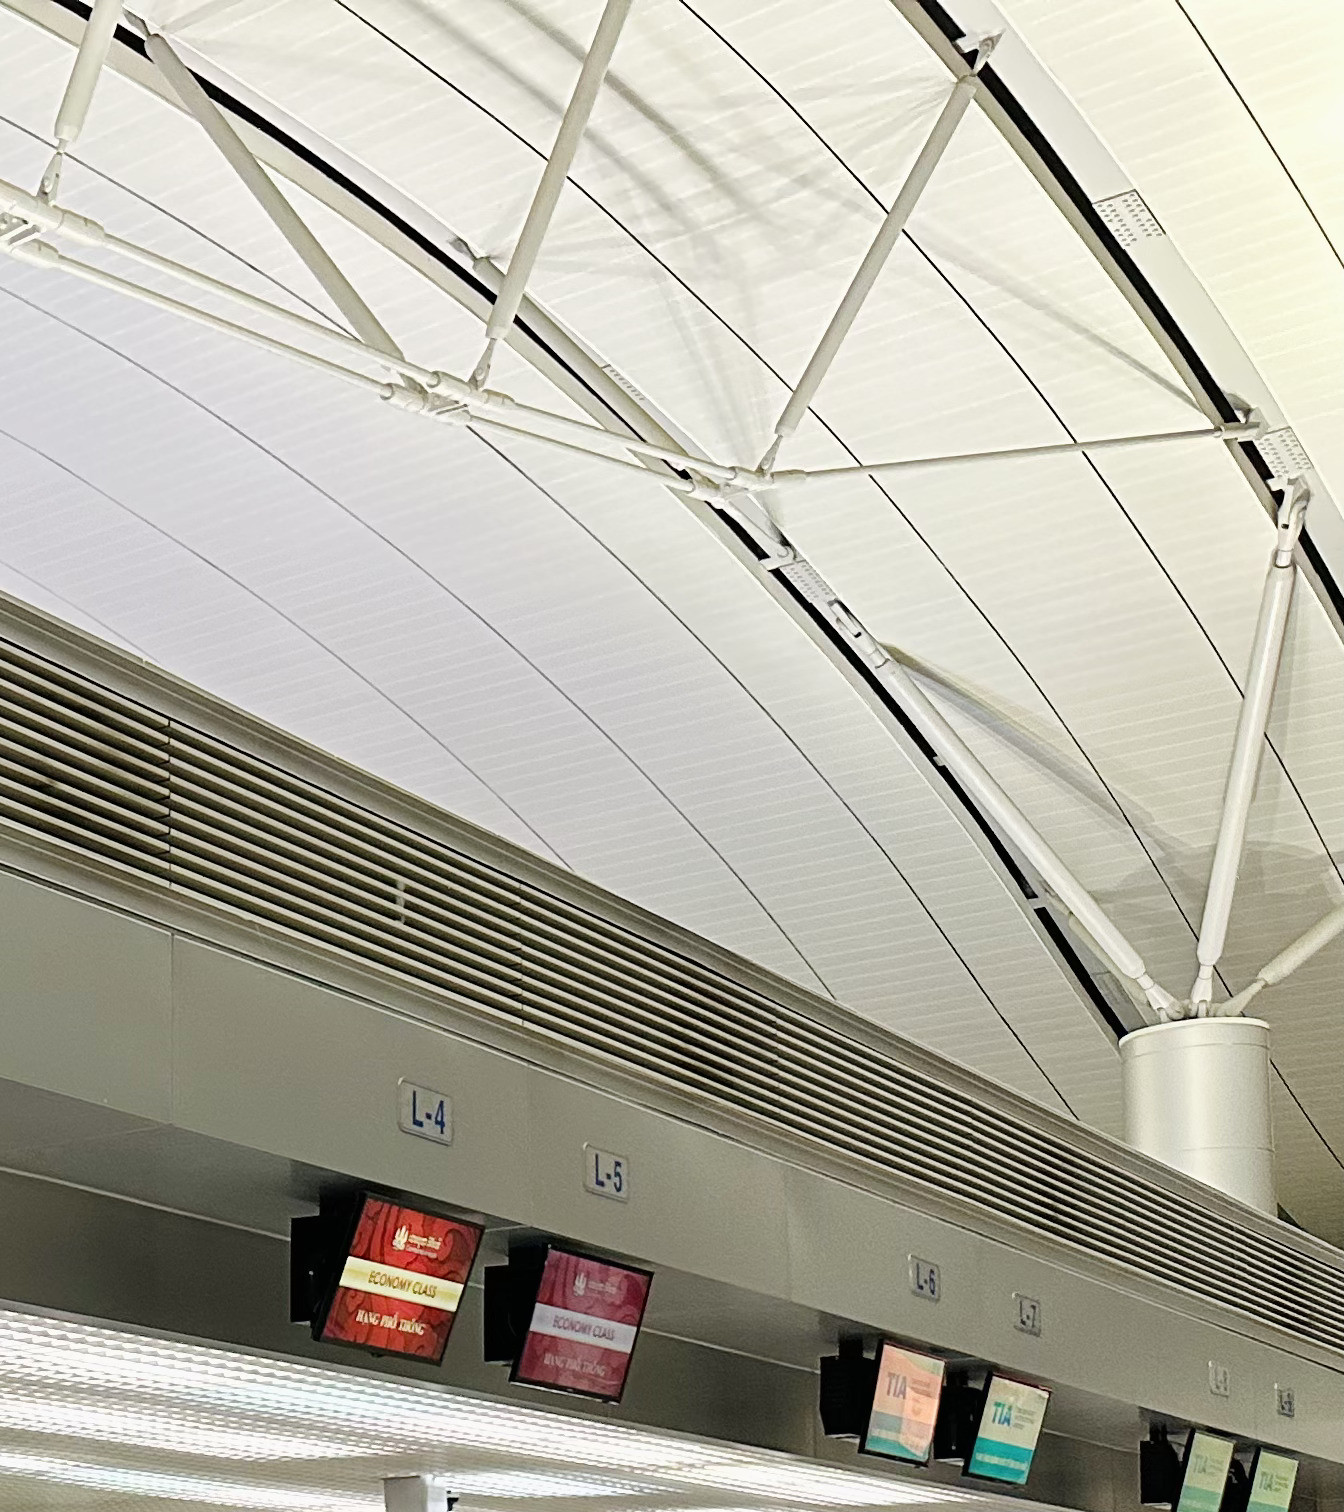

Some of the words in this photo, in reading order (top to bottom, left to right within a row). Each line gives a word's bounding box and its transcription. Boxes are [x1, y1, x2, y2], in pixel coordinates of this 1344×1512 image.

[412, 1090, 445, 1135] L-4
[594, 1153, 622, 1193] L-5
[368, 1271, 411, 1292] ECONOMY
[412, 1281, 438, 1298] CLASS
[916, 1263, 936, 1295] L-6
[886, 1372, 907, 1400] TIA
[992, 1402, 1011, 1427] TIA
